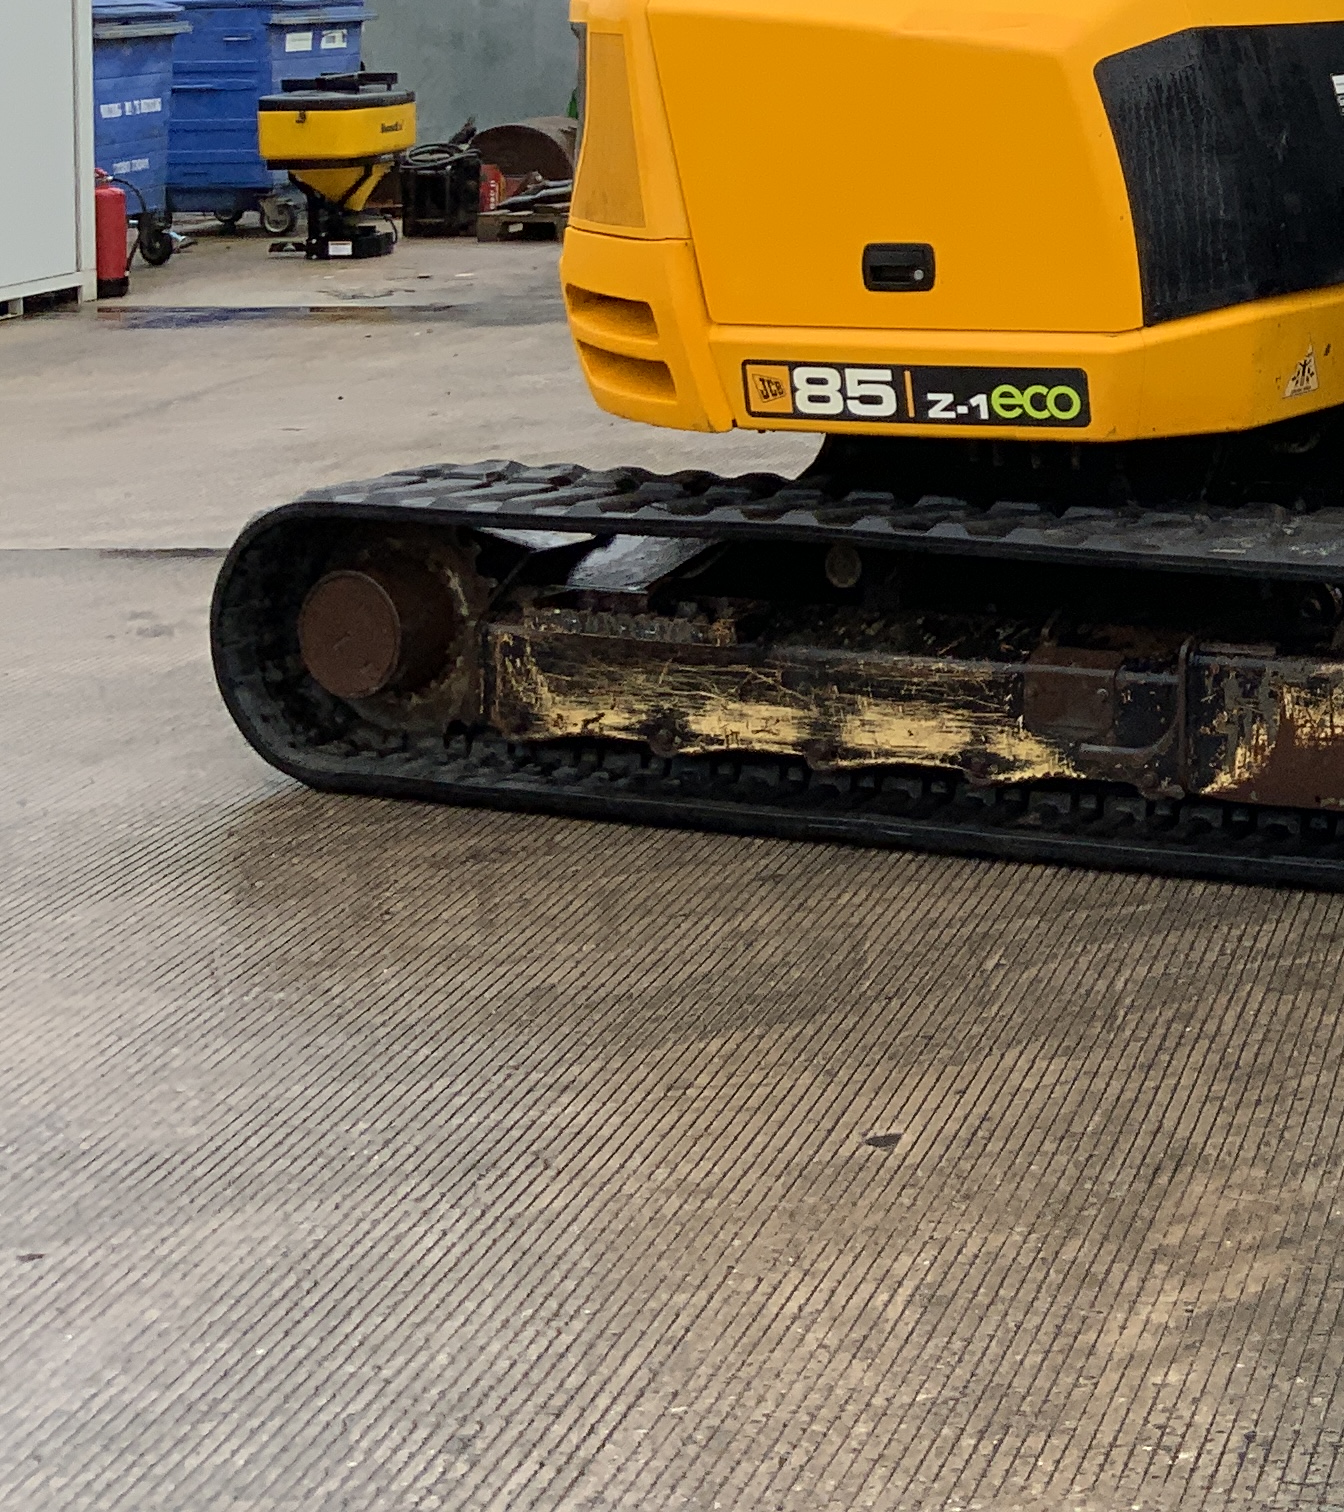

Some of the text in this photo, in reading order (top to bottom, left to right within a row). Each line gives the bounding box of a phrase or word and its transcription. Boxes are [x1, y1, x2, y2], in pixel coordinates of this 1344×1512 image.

[758, 377, 784, 400] JCB
[793, 366, 897, 418] 85
[991, 384, 1081, 421] eco
